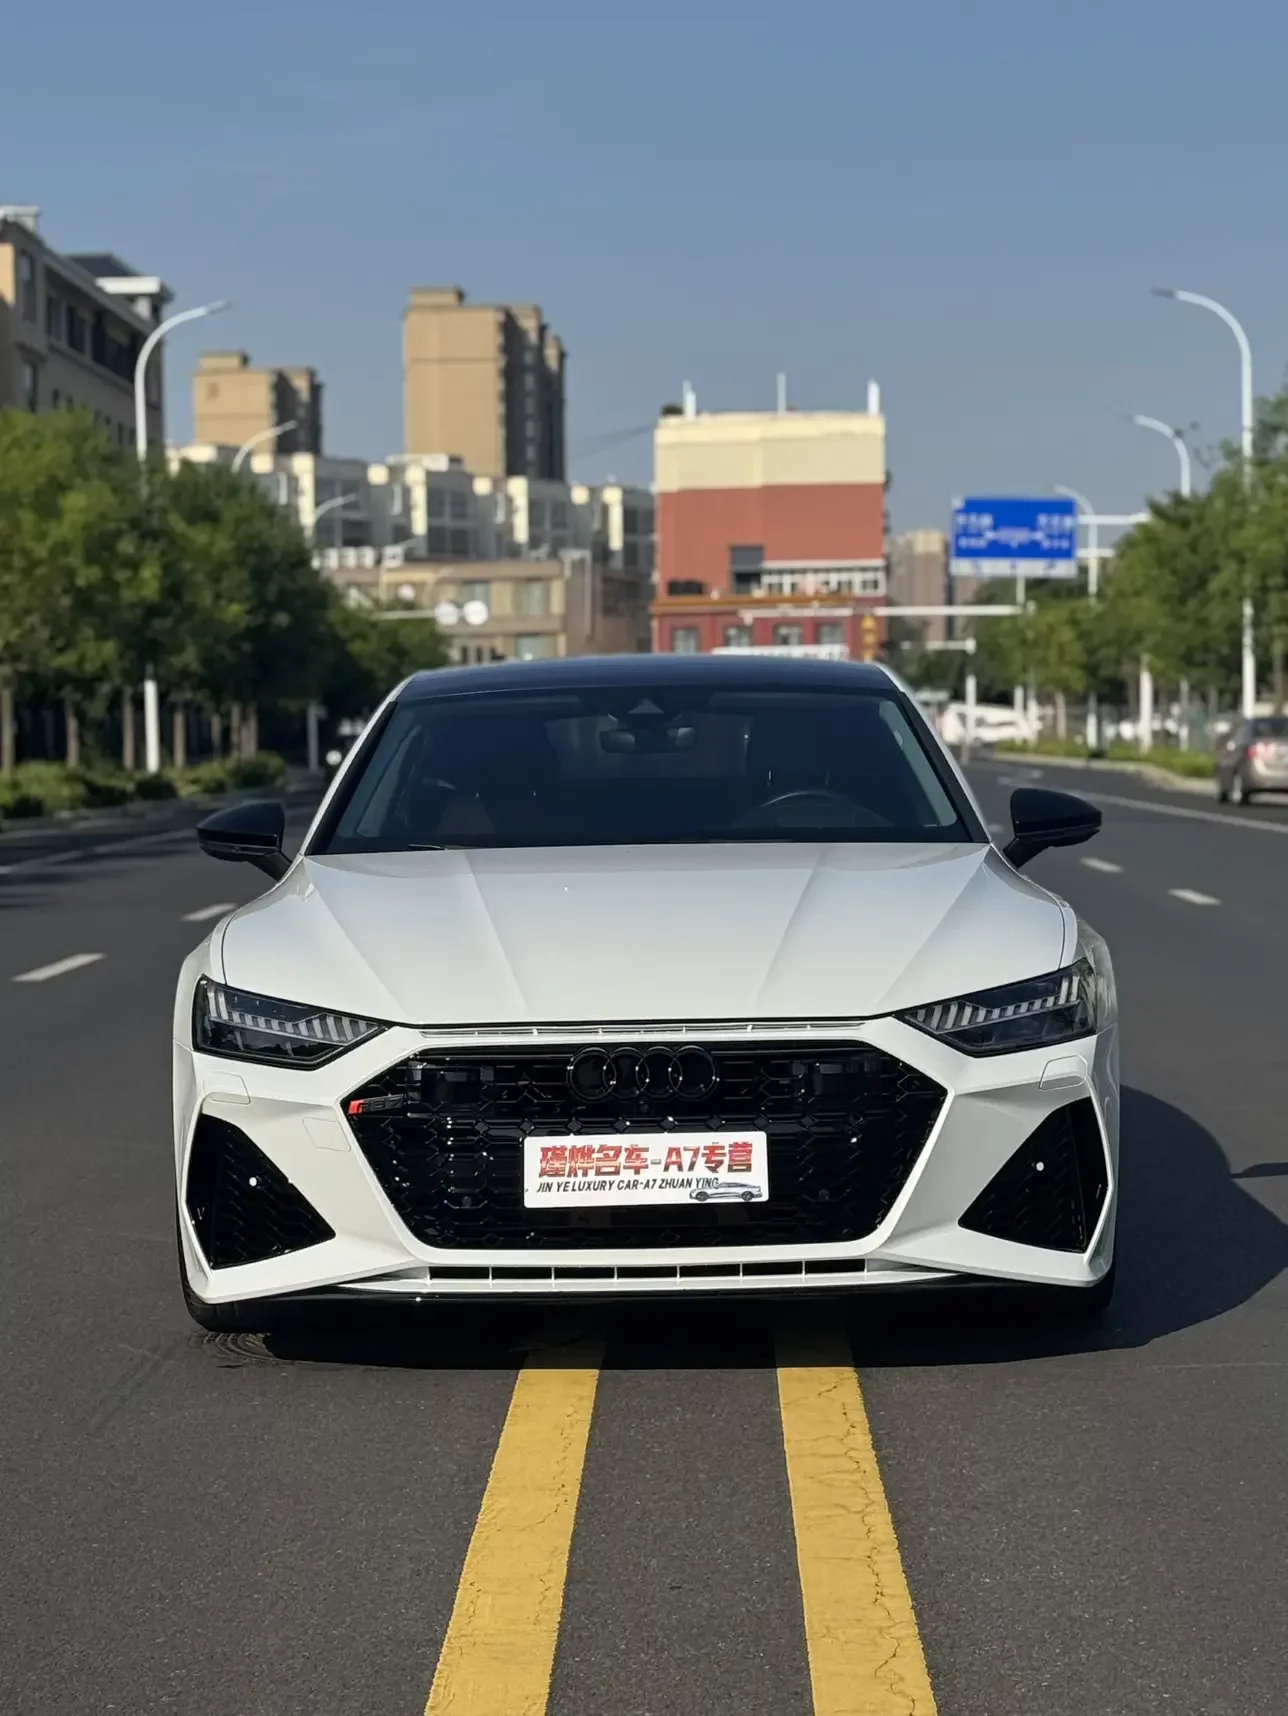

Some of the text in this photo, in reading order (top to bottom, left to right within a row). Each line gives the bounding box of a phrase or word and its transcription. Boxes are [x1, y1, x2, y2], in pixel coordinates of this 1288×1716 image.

[536, 1177, 719, 1193] JIN YE LUXURY CAR-A7 ZHUAN YING
